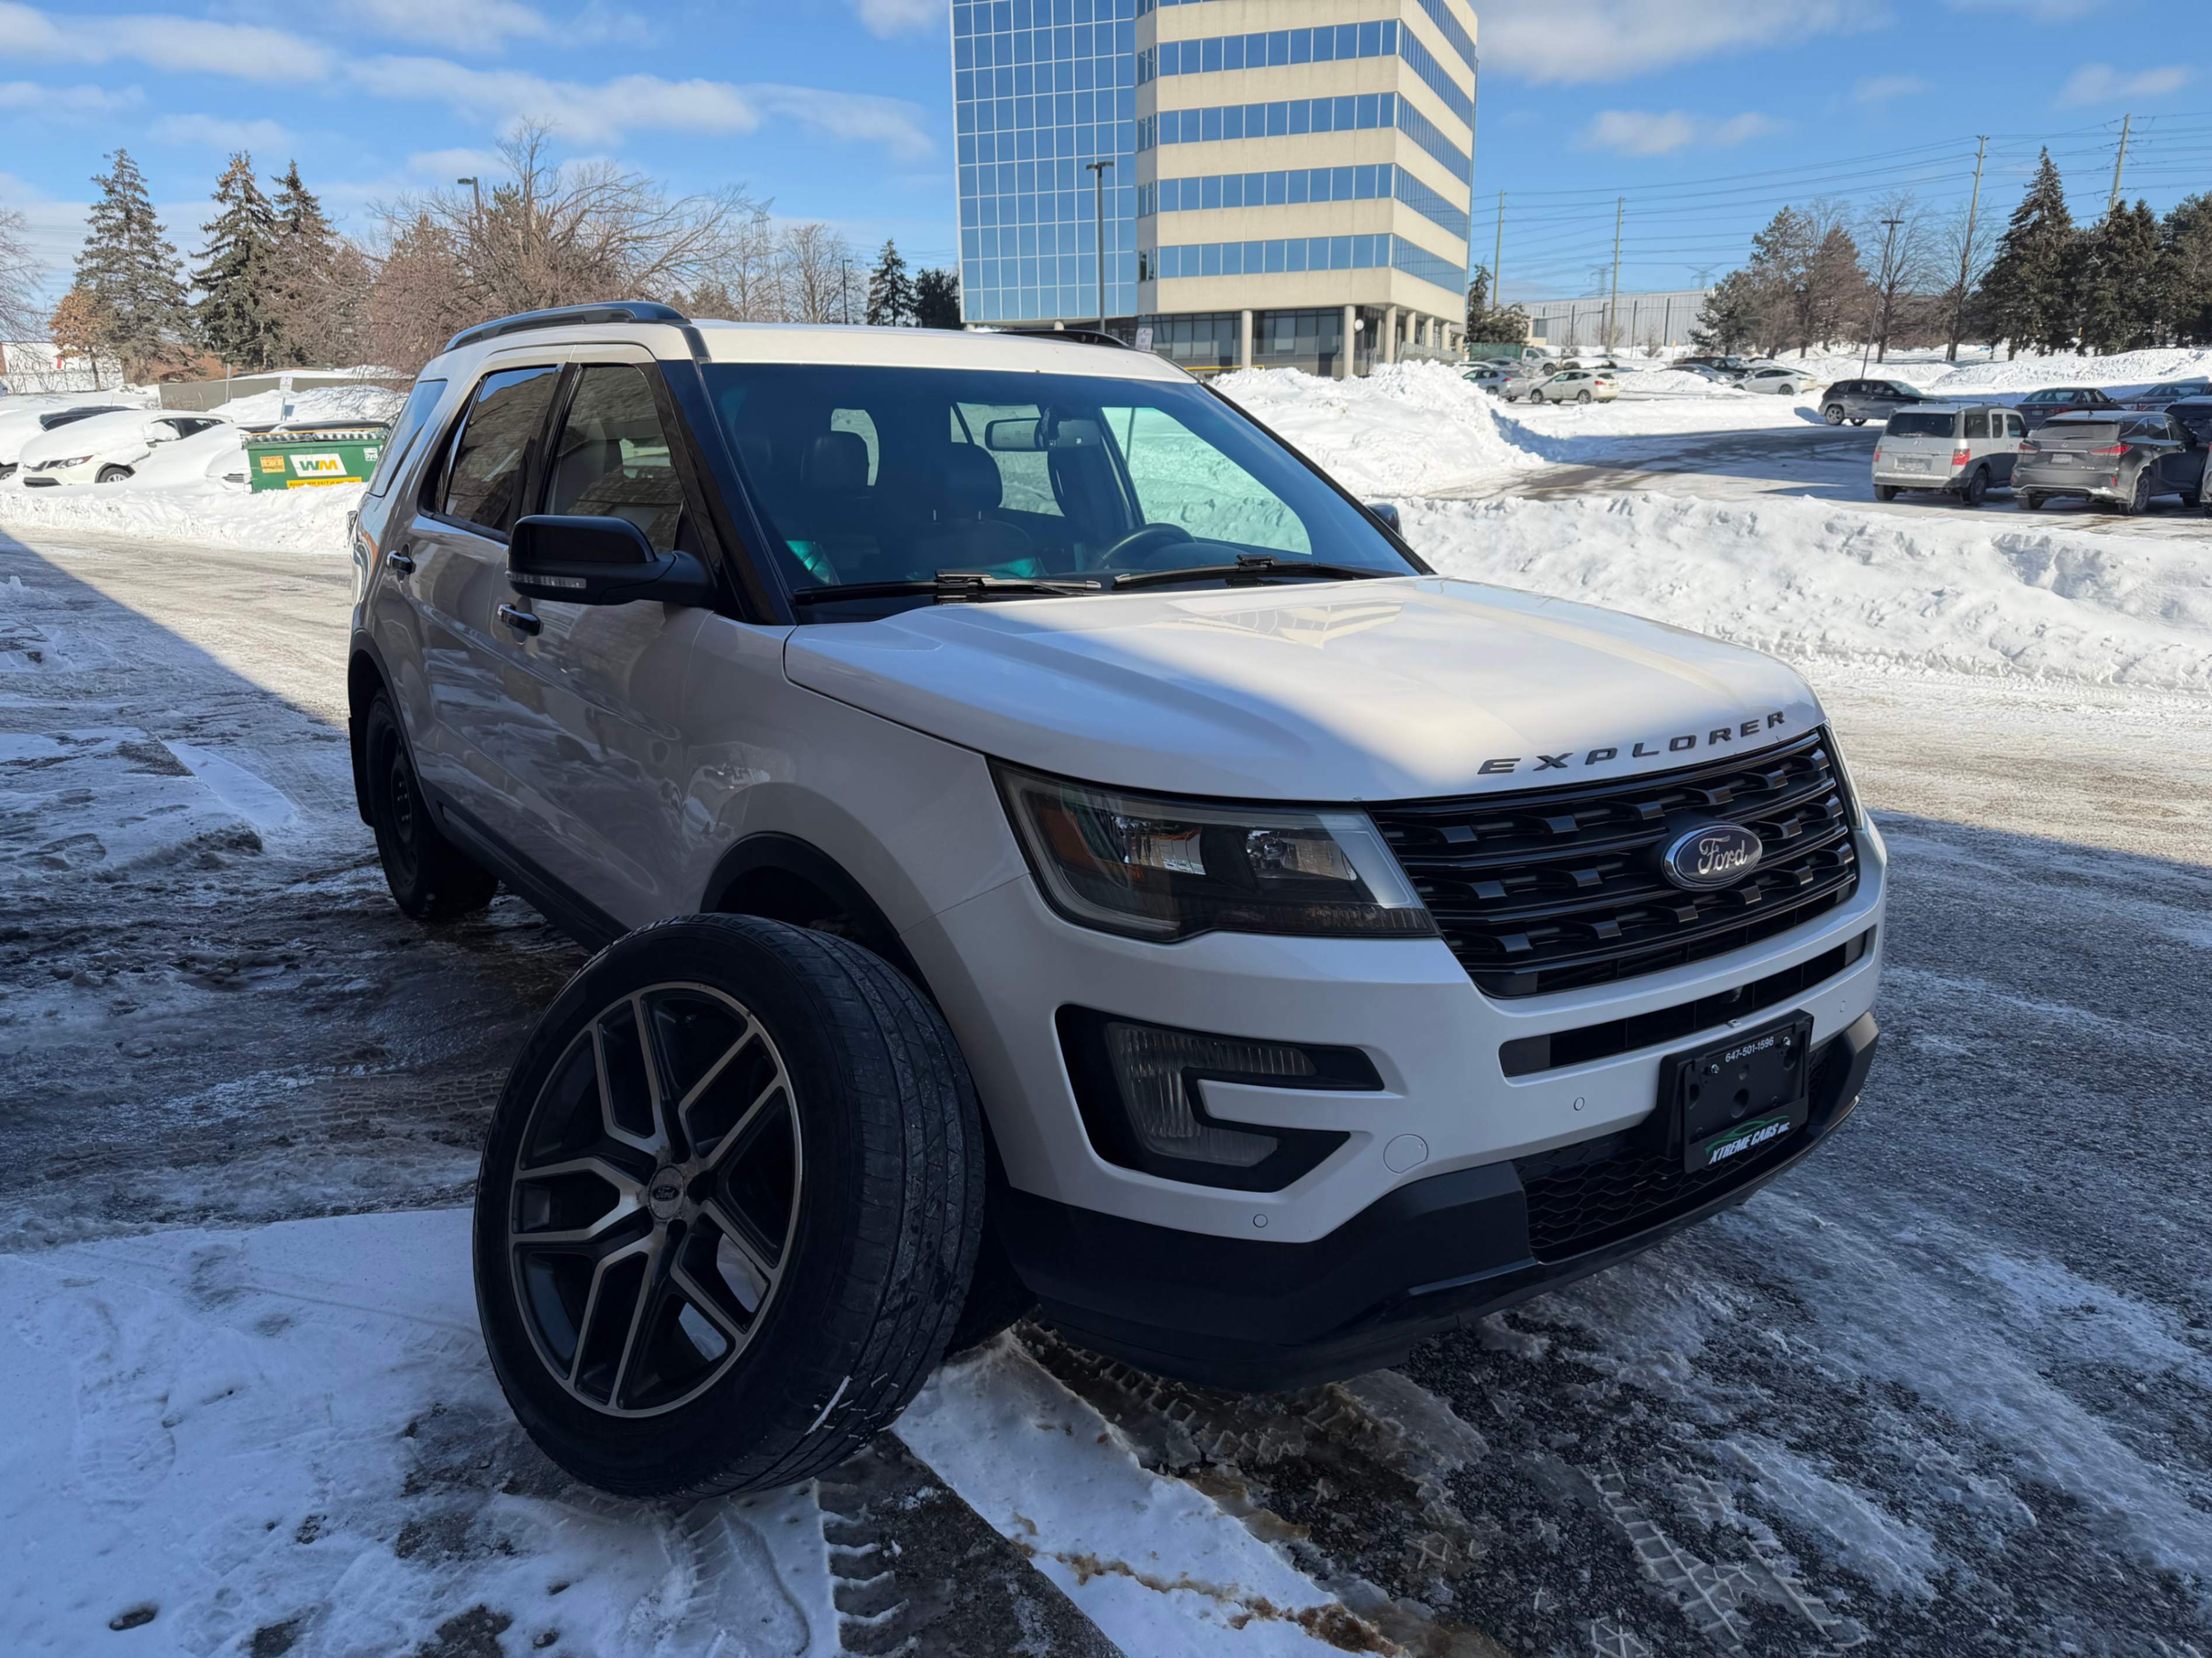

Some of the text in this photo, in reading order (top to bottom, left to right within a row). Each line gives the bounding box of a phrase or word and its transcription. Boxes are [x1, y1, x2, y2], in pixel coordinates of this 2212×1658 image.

[299, 460, 339, 470] WM
[1477, 710, 1785, 775] EXPLORER
[1697, 835, 1749, 875] Ford
[1725, 1036, 1774, 1062] 647-501-1596
[1708, 1135, 1752, 1165] XTREME
[1751, 1122, 1779, 1146] CARS
[655, 1187, 675, 1198] Ford
